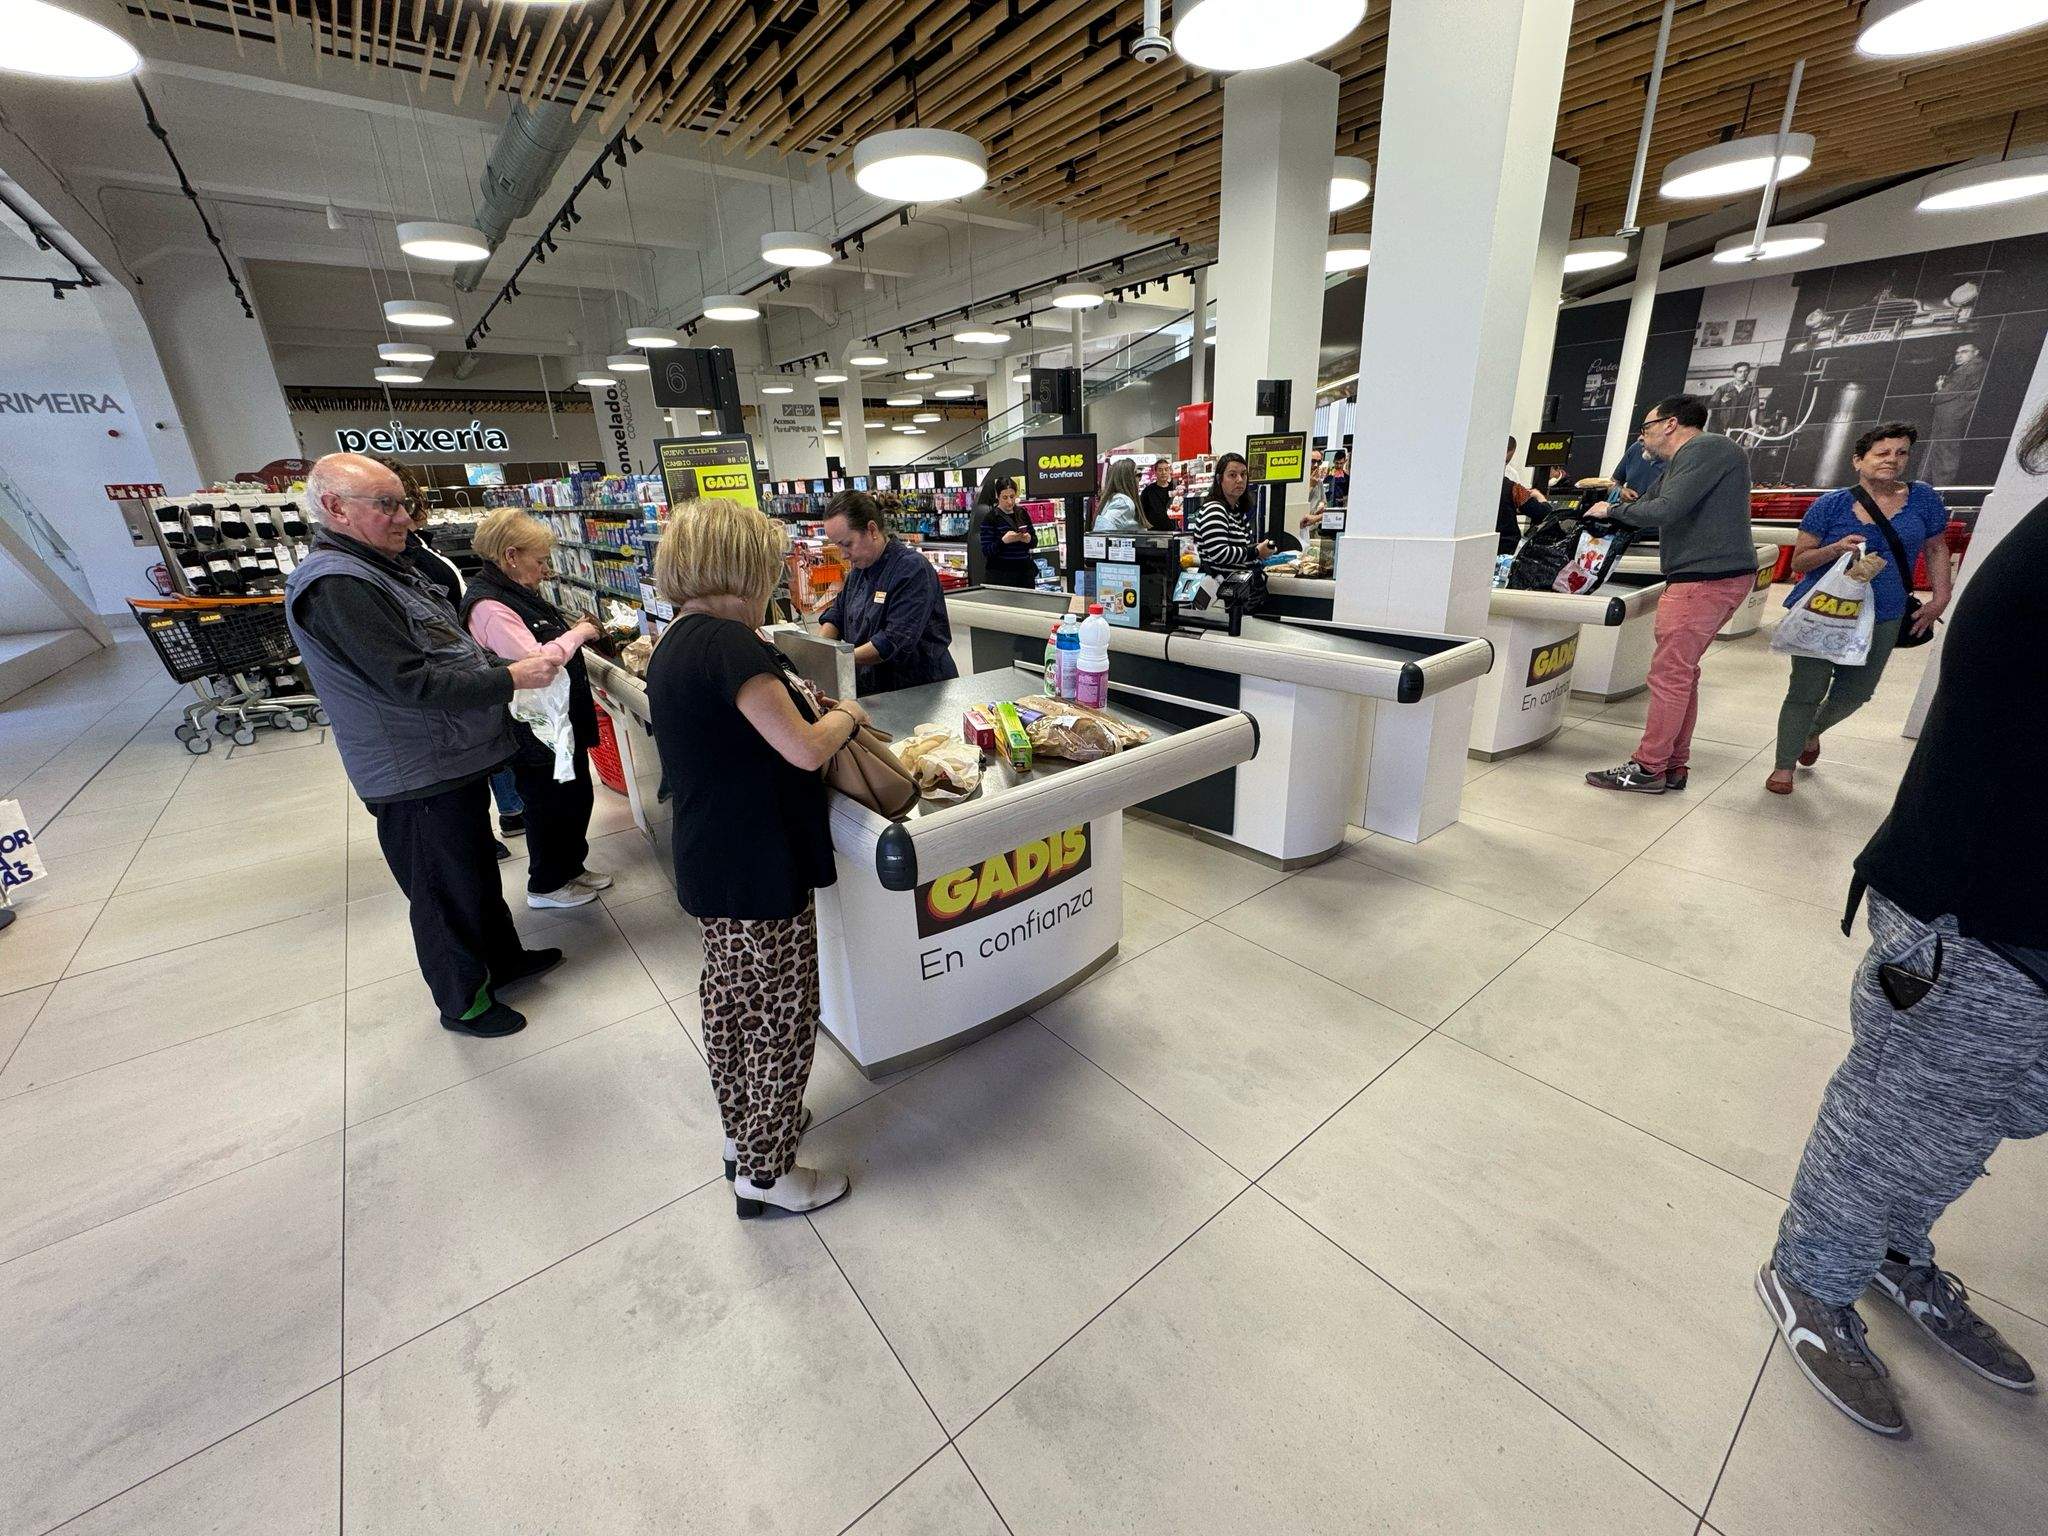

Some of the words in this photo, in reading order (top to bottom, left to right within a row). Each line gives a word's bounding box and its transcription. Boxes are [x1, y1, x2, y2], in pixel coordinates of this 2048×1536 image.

[666, 362, 687, 393] 6
[1040, 379, 1051, 403] 5
[336, 419, 509, 453] peixería
[605, 384, 632, 474] onxelado
[688, 447, 718, 455] CLIENTE
[1537, 442, 1563, 451] GADIS
[1038, 454, 1084, 469] GADIS
[1271, 457, 1297, 466] GADIS
[705, 475, 747, 489] GADIS
[1049, 471, 1083, 479] confianza
[1521, 694, 1537, 711] En
[928, 824, 1087, 921] GADIS
[920, 948, 964, 981] En
[979, 886, 1094, 958] confianza
